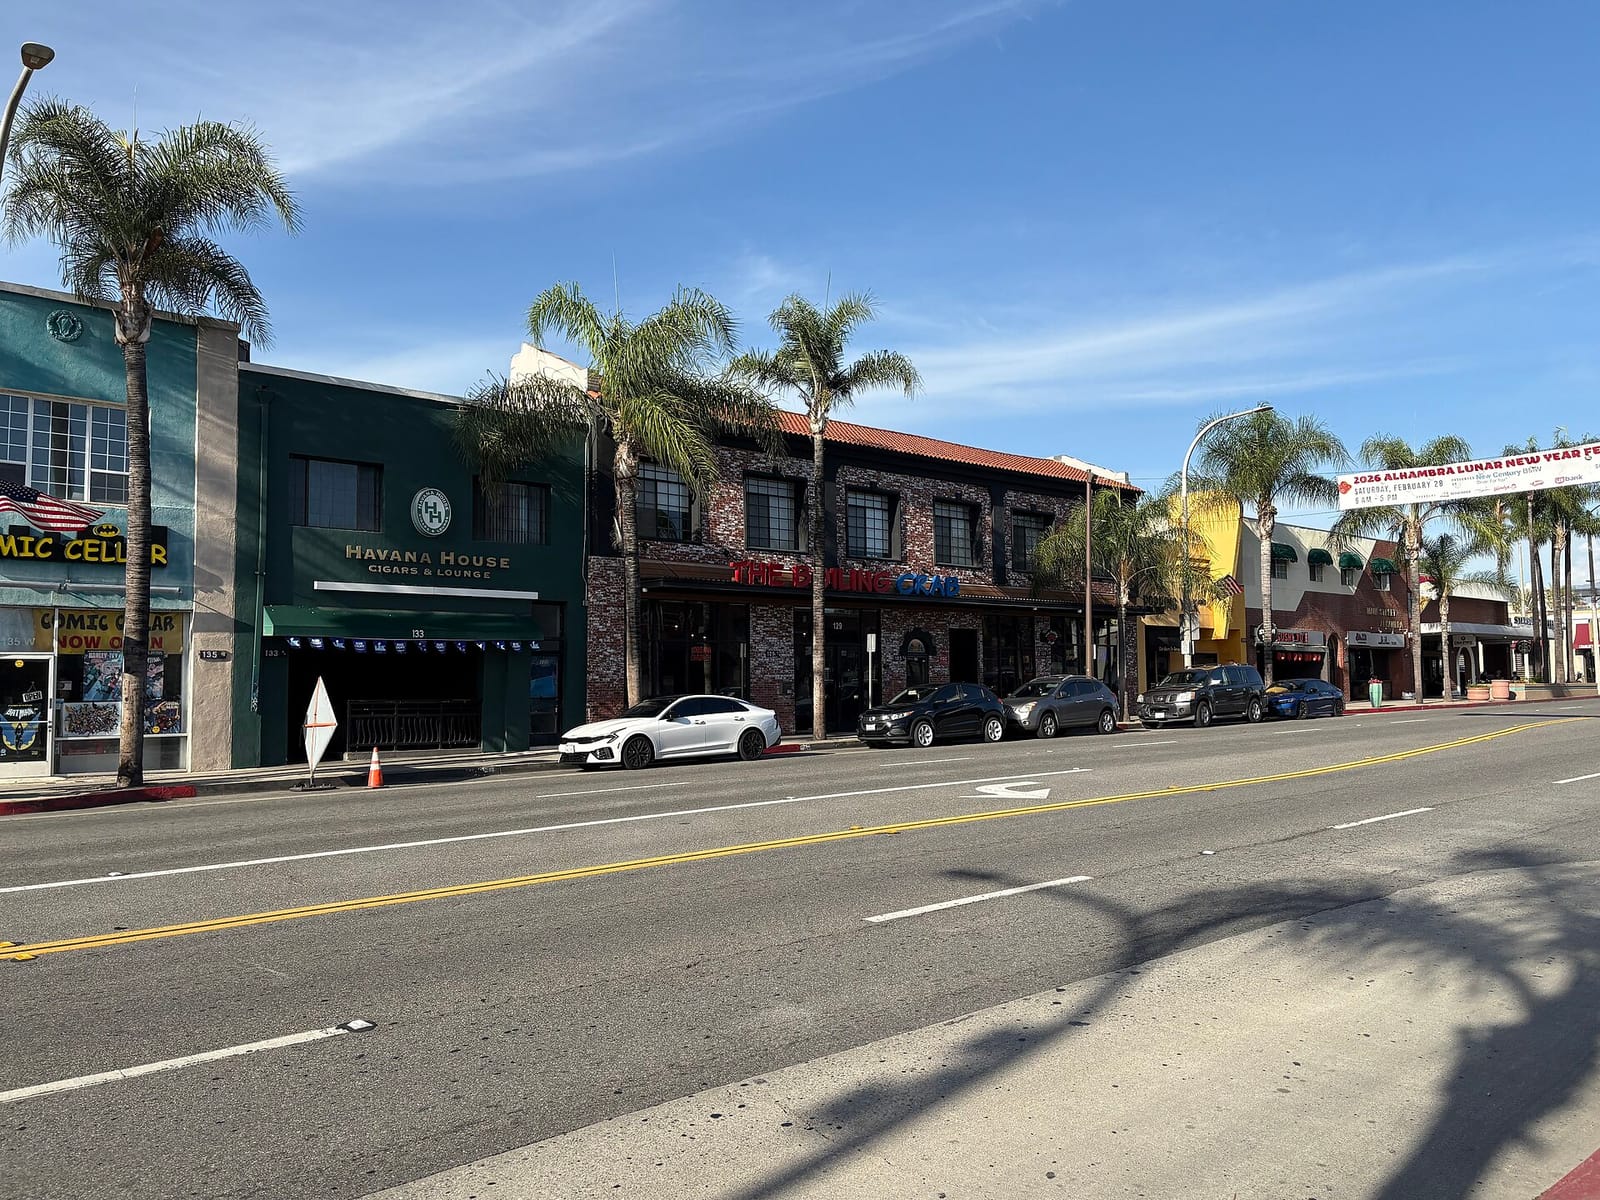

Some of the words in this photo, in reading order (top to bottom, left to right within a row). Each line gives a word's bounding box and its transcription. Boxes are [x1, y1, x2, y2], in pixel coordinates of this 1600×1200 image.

[1354, 474, 1382, 484] 2026
[1384, 466, 1455, 481] ALHAMBRA
[1457, 461, 1503, 474] LUNAR
[1506, 455, 1541, 468] NEW
[1543, 449, 1581, 462] YEAR
[1493, 470, 1521, 478] Century
[1354, 485, 1392, 495] SATURDAY,
[1393, 480, 1431, 492] FEBRUARY
[65, 539, 168, 565] CELLR
[345, 544, 432, 564] HAVANA
[440, 551, 510, 569] HOUSE
[368, 564, 418, 575] CIGARS
[424, 568, 433, 576] &
[437, 568, 491, 579] LOUNGE
[730, 561, 785, 587] THE
[896, 573, 960, 598] CRAB
[41, 612, 109, 631] COMIC
[412, 629, 425, 638] 133
[57, 635, 100, 649] NOW
[109, 636, 163, 649] ON
[202, 651, 218, 659] 135
